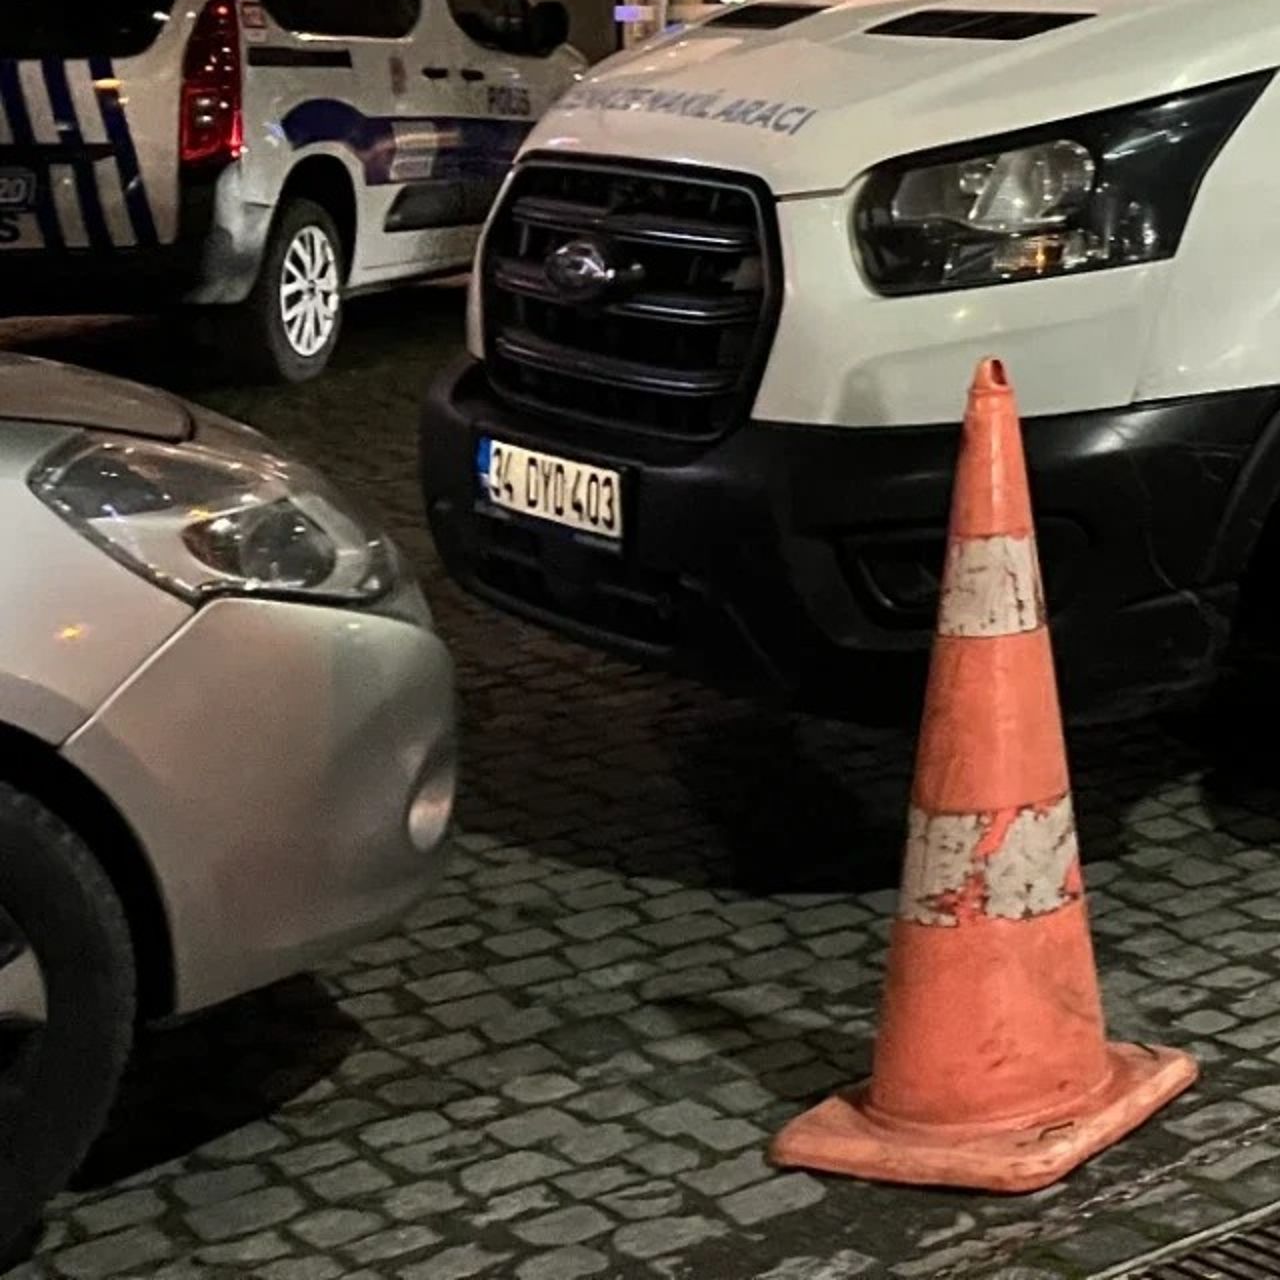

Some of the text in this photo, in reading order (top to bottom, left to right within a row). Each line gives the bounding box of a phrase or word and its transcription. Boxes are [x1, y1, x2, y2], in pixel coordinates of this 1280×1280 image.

[713, 98, 817, 136] ARACI
[491, 447, 513, 503] 34
[572, 470, 615, 530] 403
